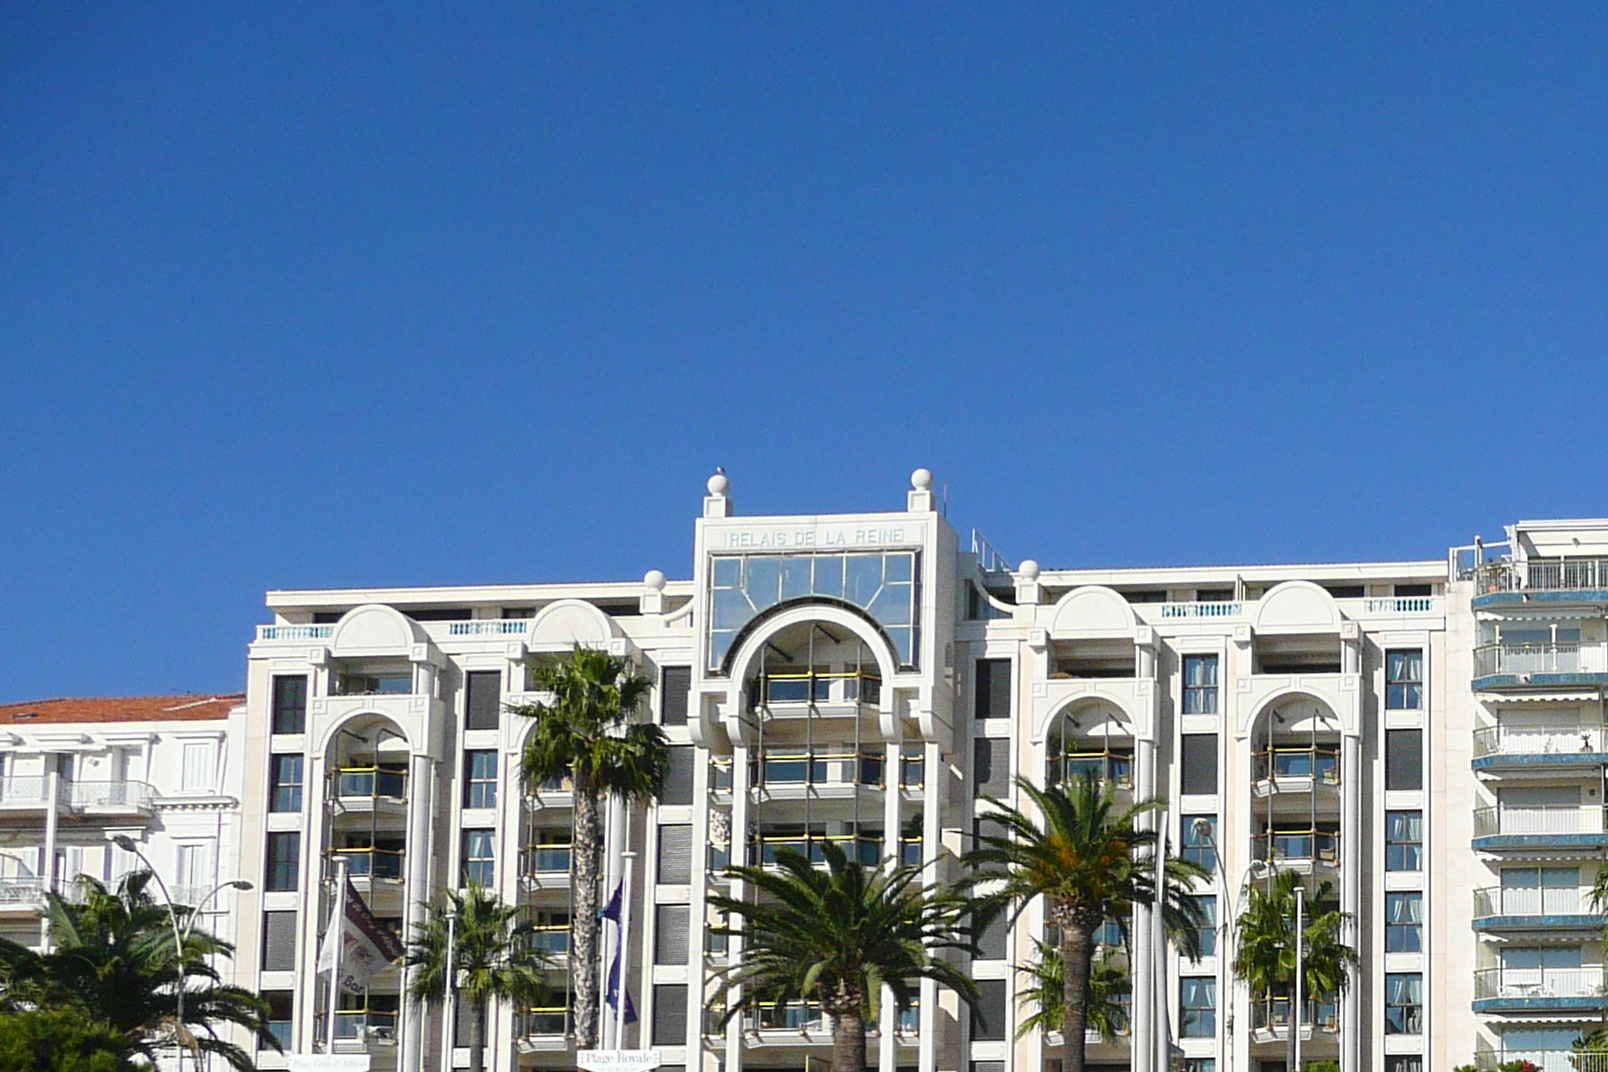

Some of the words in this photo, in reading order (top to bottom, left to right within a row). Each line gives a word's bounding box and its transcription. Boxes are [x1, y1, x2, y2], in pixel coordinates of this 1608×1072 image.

[730, 532, 786, 546] RELAIS
[795, 531, 815, 545] DE
[826, 530, 846, 544] LA
[856, 529, 903, 544] REINE
[344, 975, 364, 992] Bar
[587, 1052, 614, 1064] Plage
[617, 1051, 652, 1065] Royale
